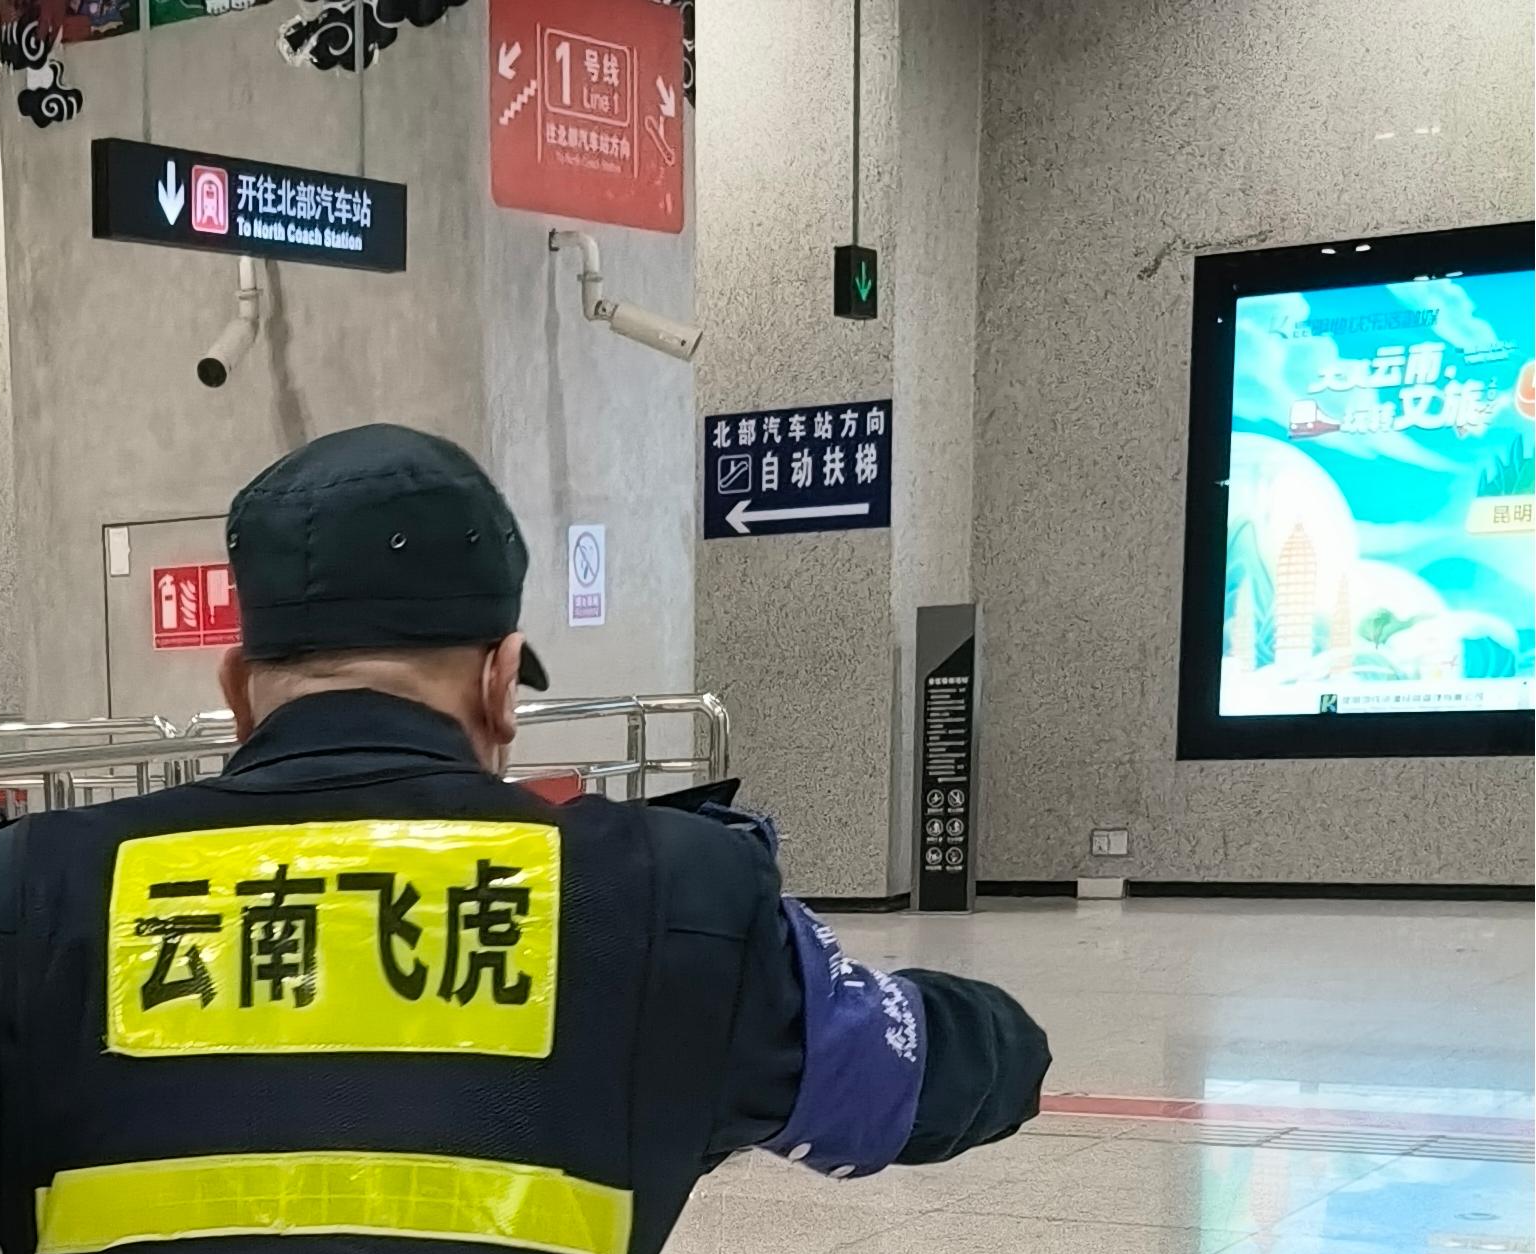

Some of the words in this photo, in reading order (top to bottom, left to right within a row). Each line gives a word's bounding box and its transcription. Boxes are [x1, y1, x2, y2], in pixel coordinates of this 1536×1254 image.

[556, 41, 571, 106] 1
[584, 49, 620, 87] 号线
[583, 86, 610, 114] Line
[237, 173, 371, 228] 开往北部汽车站
[237, 215, 252, 237] To
[253, 218, 285, 241] North
[287, 222, 322, 246] Coach
[324, 226, 363, 251] Station
[712, 406, 885, 448] 北部汽车站方向
[761, 442, 878, 492] 自动扶梯
[1494, 504, 1532, 524] 昆明
[134, 859, 533, 1012] 云南飞虎
